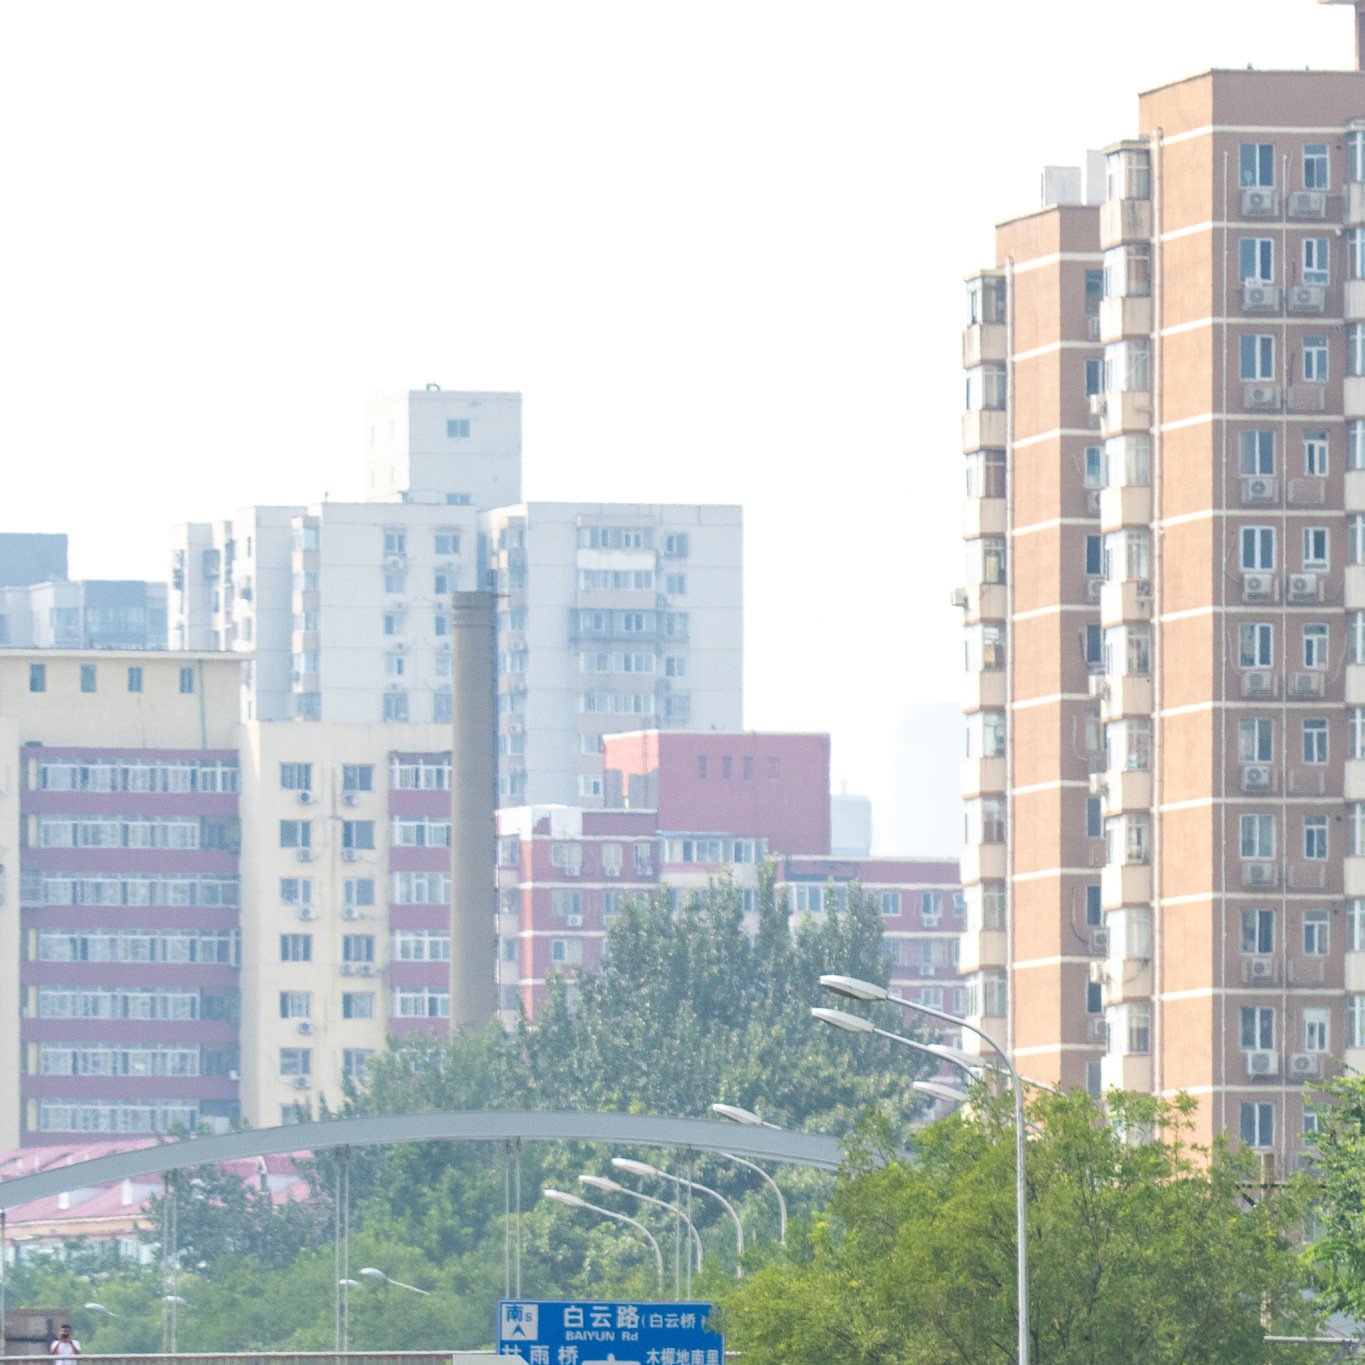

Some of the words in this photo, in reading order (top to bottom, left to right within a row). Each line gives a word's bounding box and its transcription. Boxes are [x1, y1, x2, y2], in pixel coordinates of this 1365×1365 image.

[563, 1305, 640, 1329] 白云路
[565, 1331, 615, 1341] BAIYUN
[621, 1332, 638, 1341] Rd
